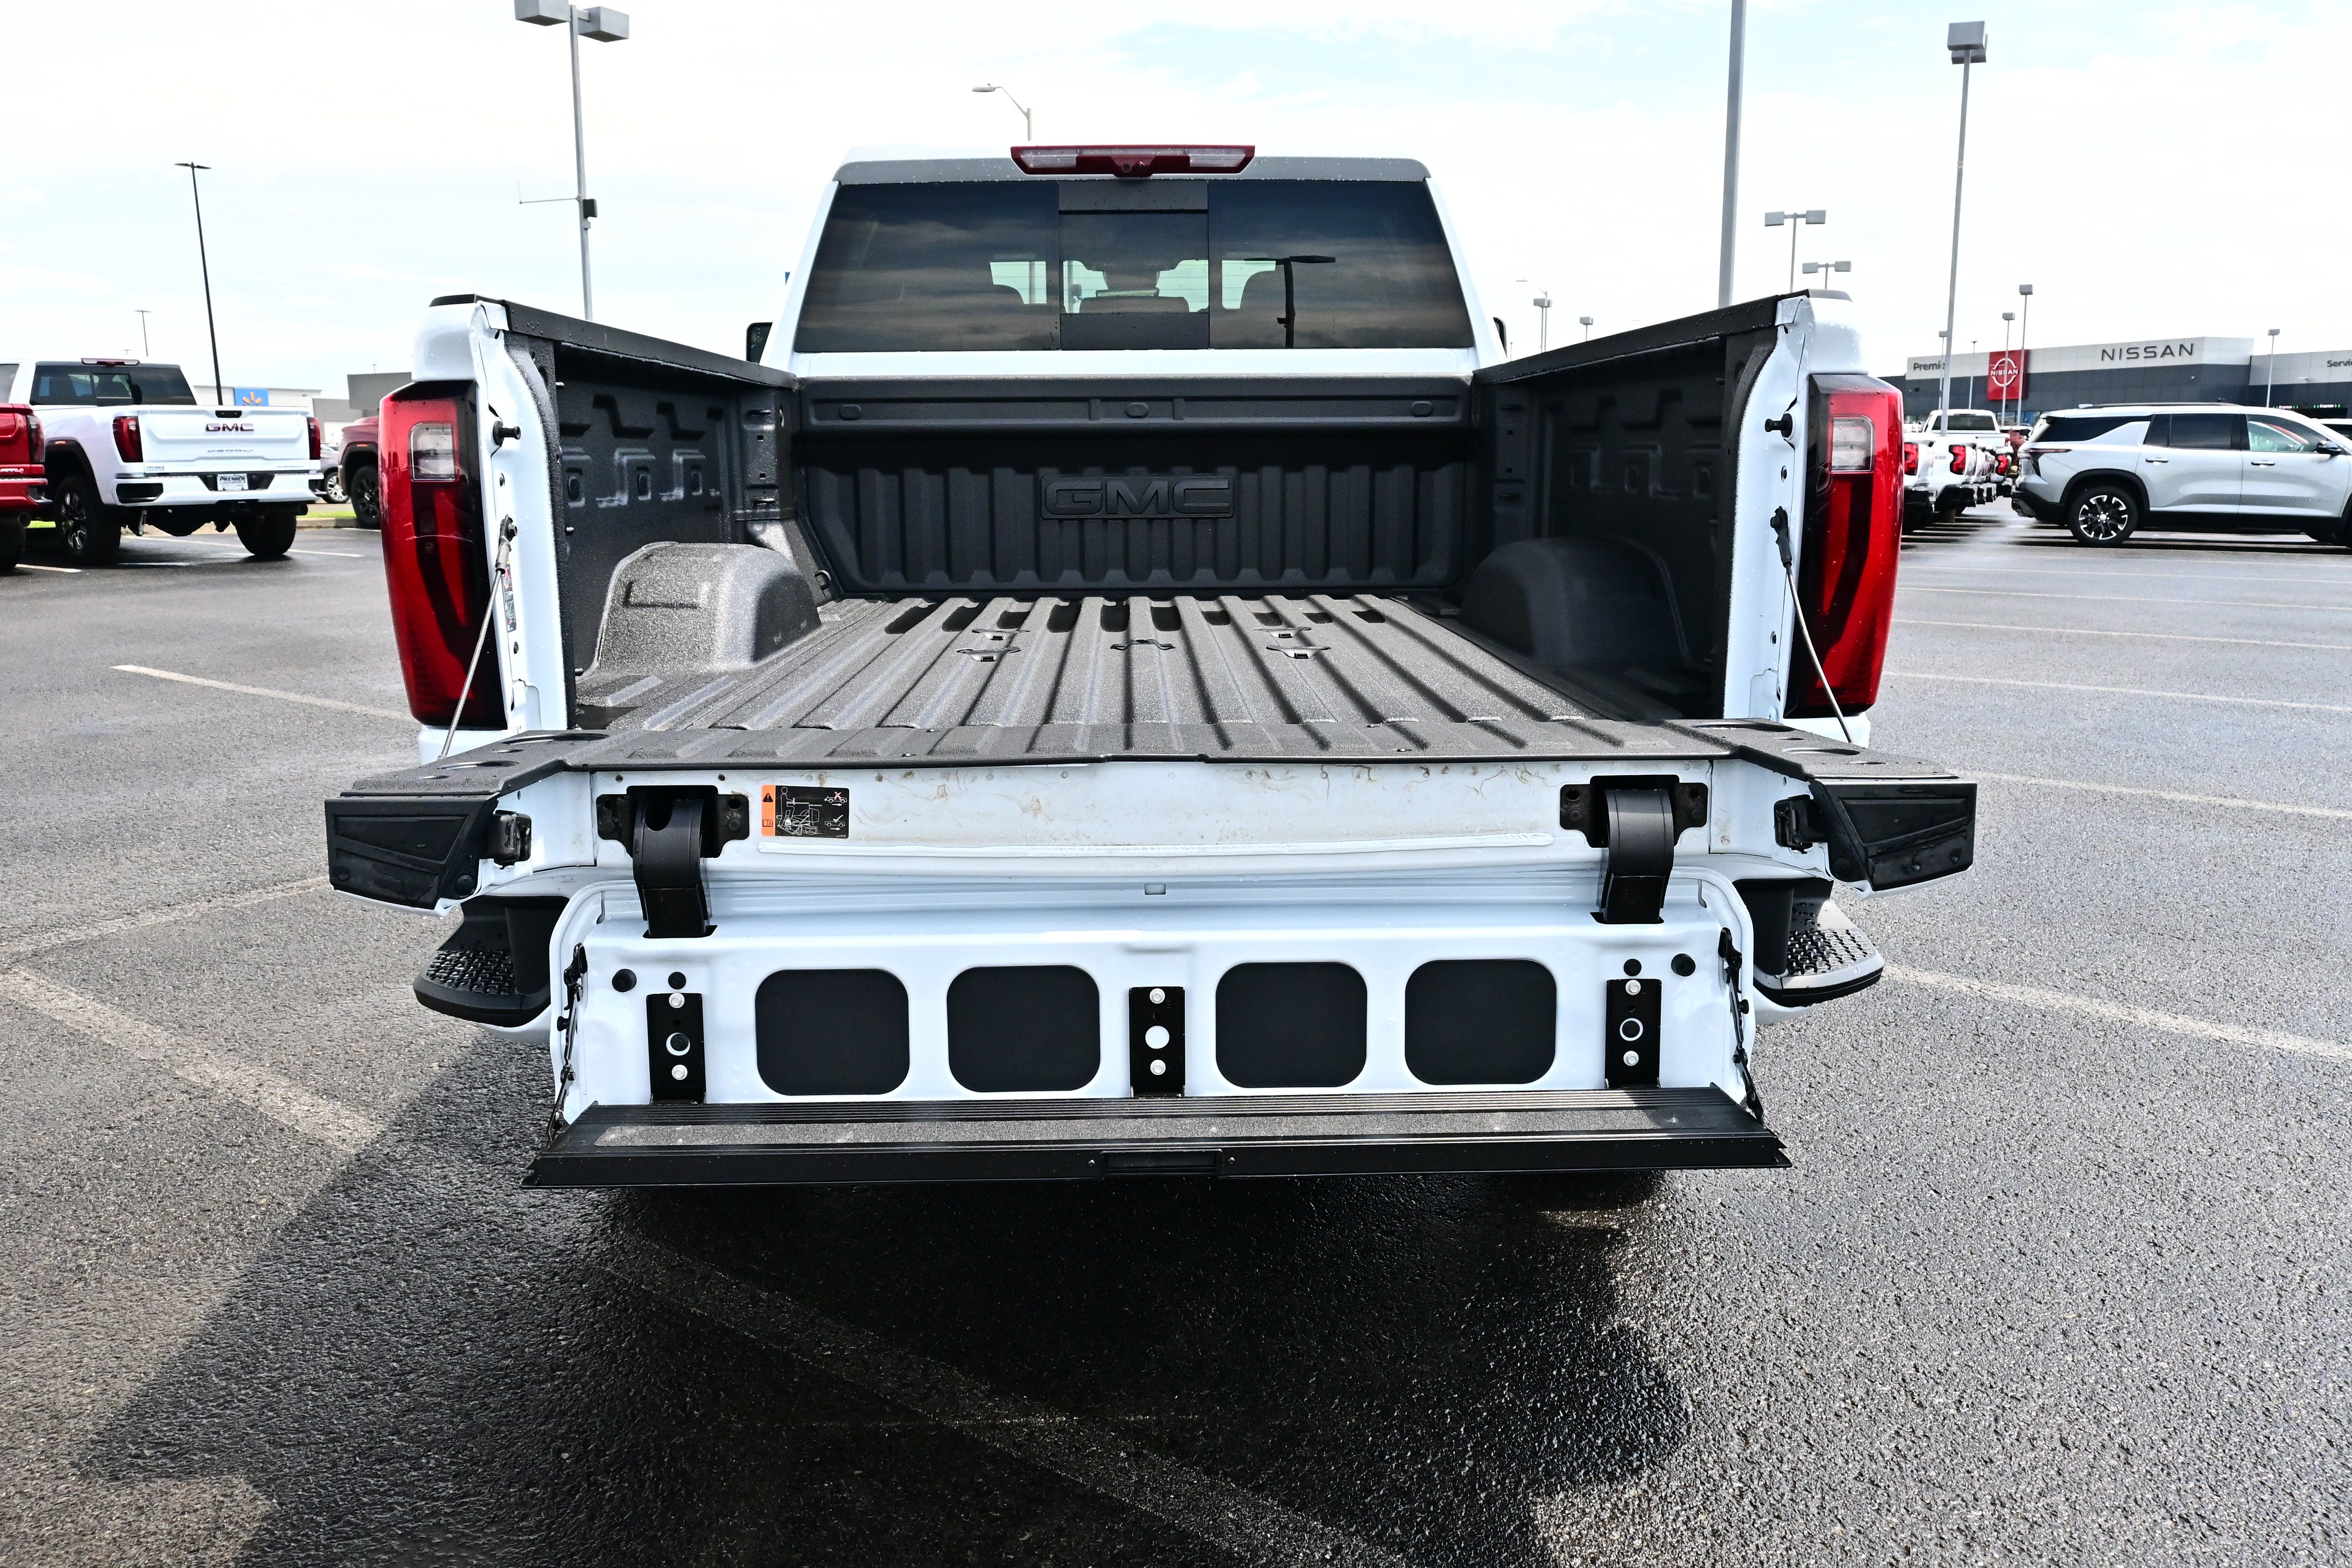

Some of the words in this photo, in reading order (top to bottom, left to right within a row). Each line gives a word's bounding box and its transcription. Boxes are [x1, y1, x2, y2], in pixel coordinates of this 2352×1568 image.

[2101, 343, 2194, 361] NISSAN
[2327, 358, 2352, 367] Servi
[206, 423, 254, 432] GMC
[1045, 480, 1230, 515] GMC
